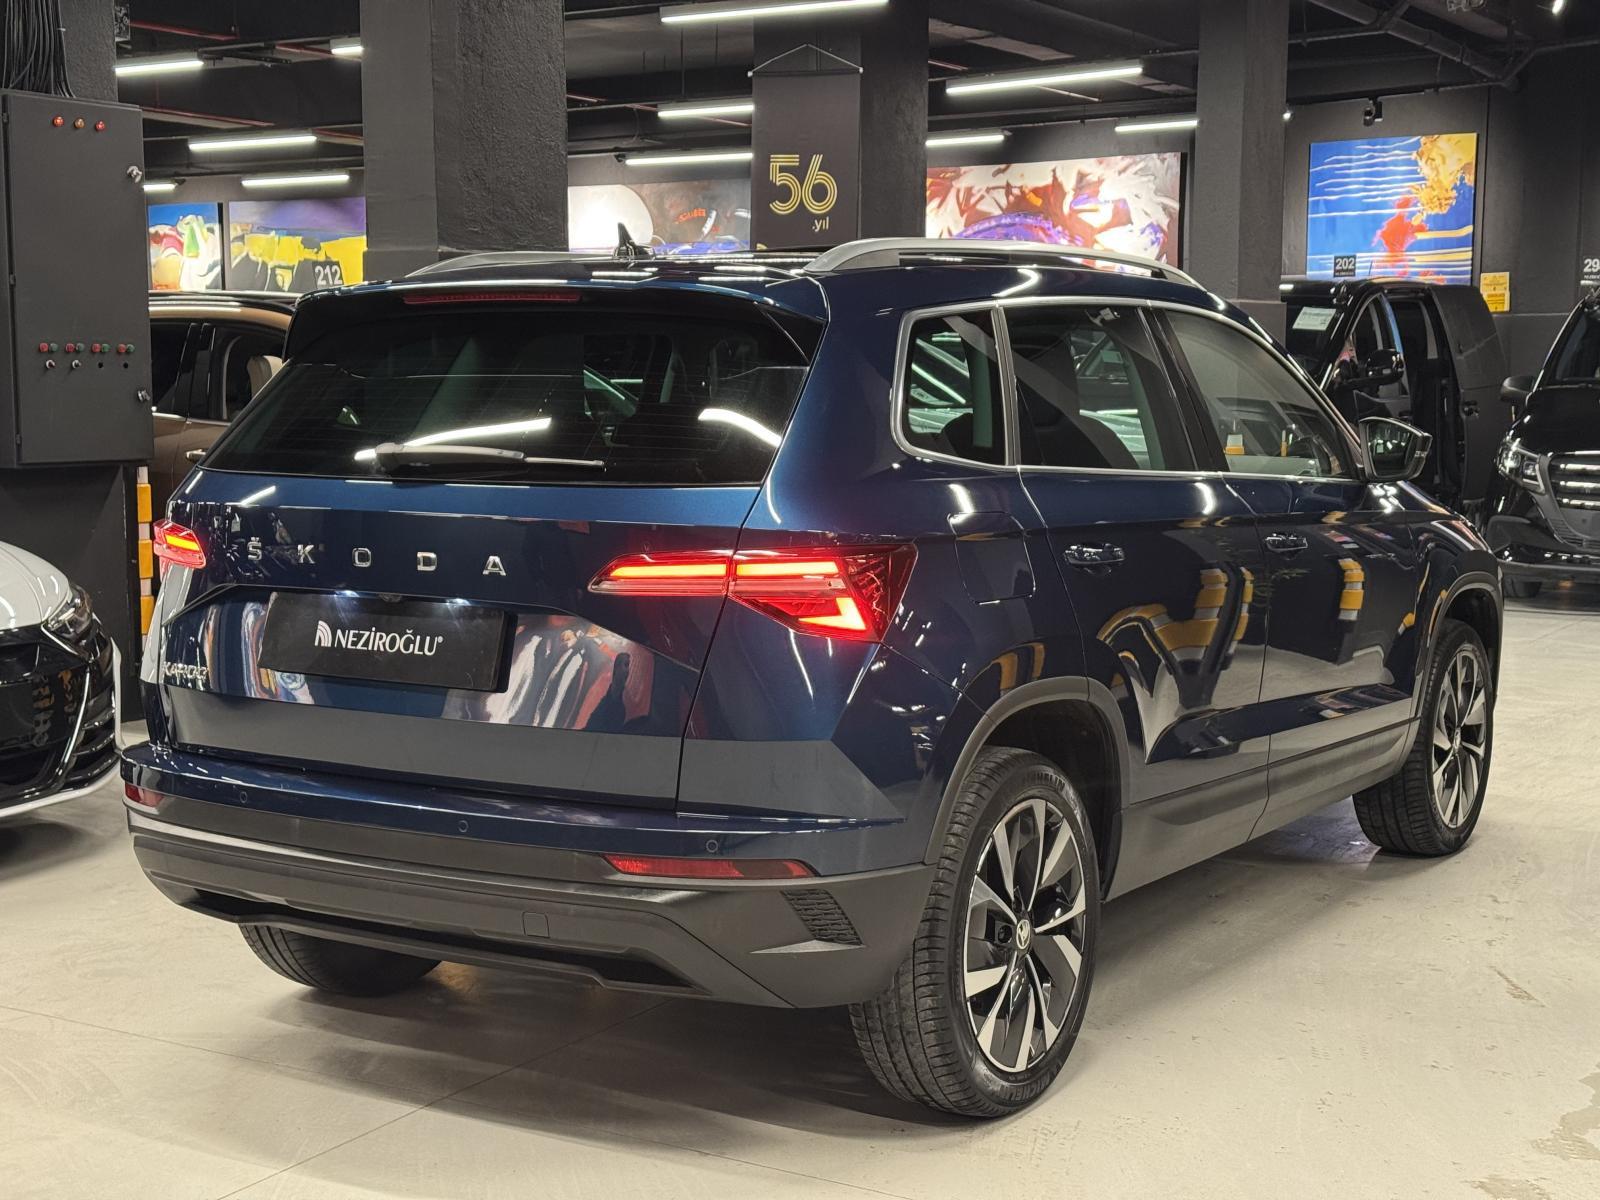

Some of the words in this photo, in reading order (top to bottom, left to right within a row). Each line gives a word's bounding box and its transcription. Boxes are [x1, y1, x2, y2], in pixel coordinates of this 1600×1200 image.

[769, 154, 837, 214] 56
[315, 265, 343, 285] 212
[1335, 257, 1355, 270] 202
[247, 536, 507, 577] ŠKODA
